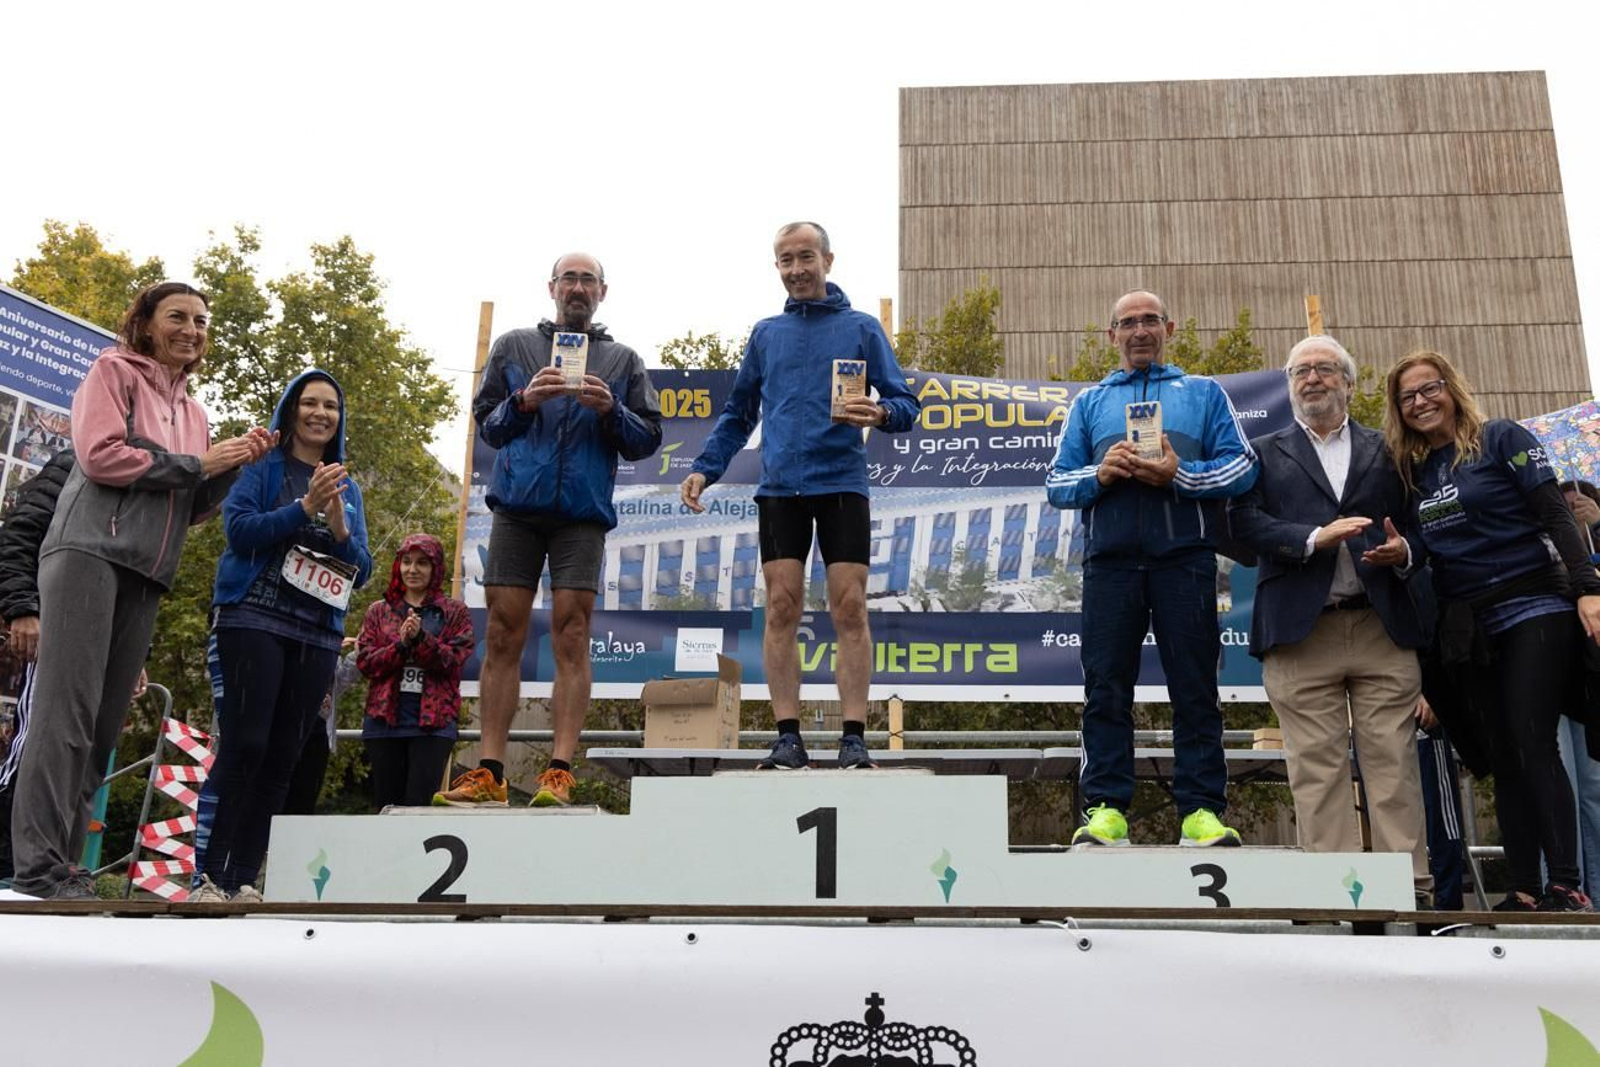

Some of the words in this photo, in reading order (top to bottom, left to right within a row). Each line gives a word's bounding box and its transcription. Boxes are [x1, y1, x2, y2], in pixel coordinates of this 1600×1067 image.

[0, 307, 72, 344] Aniversario
[73, 338, 88, 351] de
[89, 344, 100, 356] la
[11, 344, 20, 356] y
[21, 347, 34, 360] la
[31, 336, 39, 348] y
[40, 340, 71, 360] Gran
[0, 363, 24, 379] endo
[26, 374, 64, 395] deporte,
[837, 362, 865, 375] XXV
[656, 388, 712, 418] 025
[906, 378, 1088, 405] ARRER
[914, 402, 1069, 431] OPULA
[1129, 403, 1158, 419] XXV
[893, 438, 911, 454] y
[919, 436, 980, 455] gran
[911, 453, 934, 474] la
[612, 499, 672, 516] talina
[679, 501, 701, 516] d
[708, 499, 757, 520] Aleja
[1418, 482, 1460, 511] 25
[294, 557, 344, 597] 1106
[797, 642, 1018, 673] vilterra
[796, 806, 838, 899] 1
[417, 834, 469, 904] 2
[1190, 863, 1231, 908] 3
